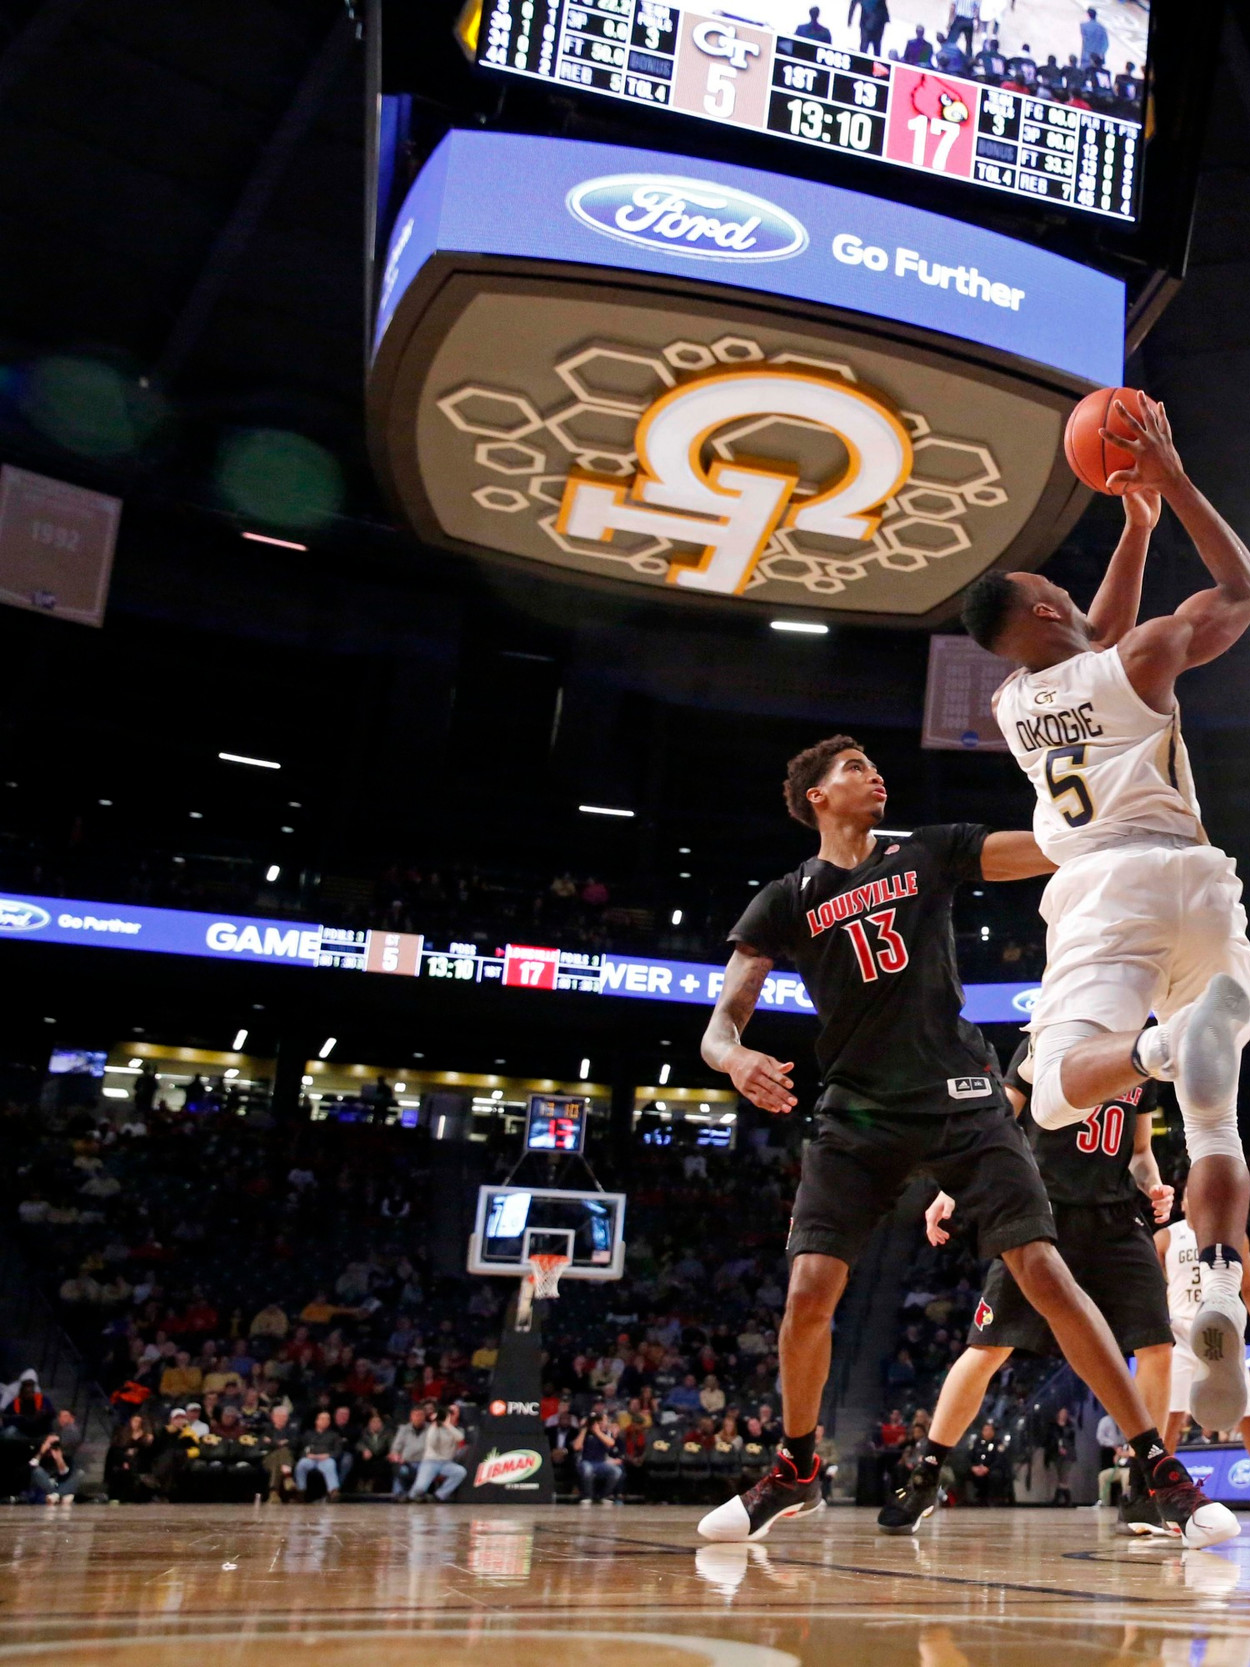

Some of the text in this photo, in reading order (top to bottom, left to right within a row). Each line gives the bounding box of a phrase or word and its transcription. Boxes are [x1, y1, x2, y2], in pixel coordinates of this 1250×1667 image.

[564, 34, 585, 55] FT
[644, 26, 660, 49] 3
[692, 20, 761, 70] GT
[655, 85, 666, 102] 4
[703, 62, 738, 118] 5
[783, 65, 878, 108] 1ST 13
[1025, 101, 1044, 120] FG
[787, 99, 873, 151] 13:10
[992, 115, 1005, 136] 3
[907, 114, 961, 170] 17
[1021, 148, 1038, 168] FT
[1002, 170, 1012, 186] 4
[1020, 172, 1072, 200] REB 7
[615, 182, 762, 250] Ford
[1120, 200, 1130, 216] 4
[832, 233, 1026, 311] Go Further
[1034, 691, 1057, 705] GT
[1016, 702, 1104, 752] OKOGIE
[1045, 743, 1097, 828] 5
[806, 871, 918, 938] LOUISVILLE
[59, 913, 142, 935] Go Further
[206, 922, 320, 959] GAME
[450, 942, 477, 956] POSS
[840, 908, 909, 983] 13
[382, 947, 399, 972] 5
[428, 956, 474, 980] 13:10
[519, 961, 545, 985] 17
[680, 974, 700, 993] +
[1076, 1103, 1125, 1157] 30
[1185, 1288, 1202, 1303] TE
[507, 1401, 540, 1416] PNC
[473, 1455, 536, 1487] LIBMAN
